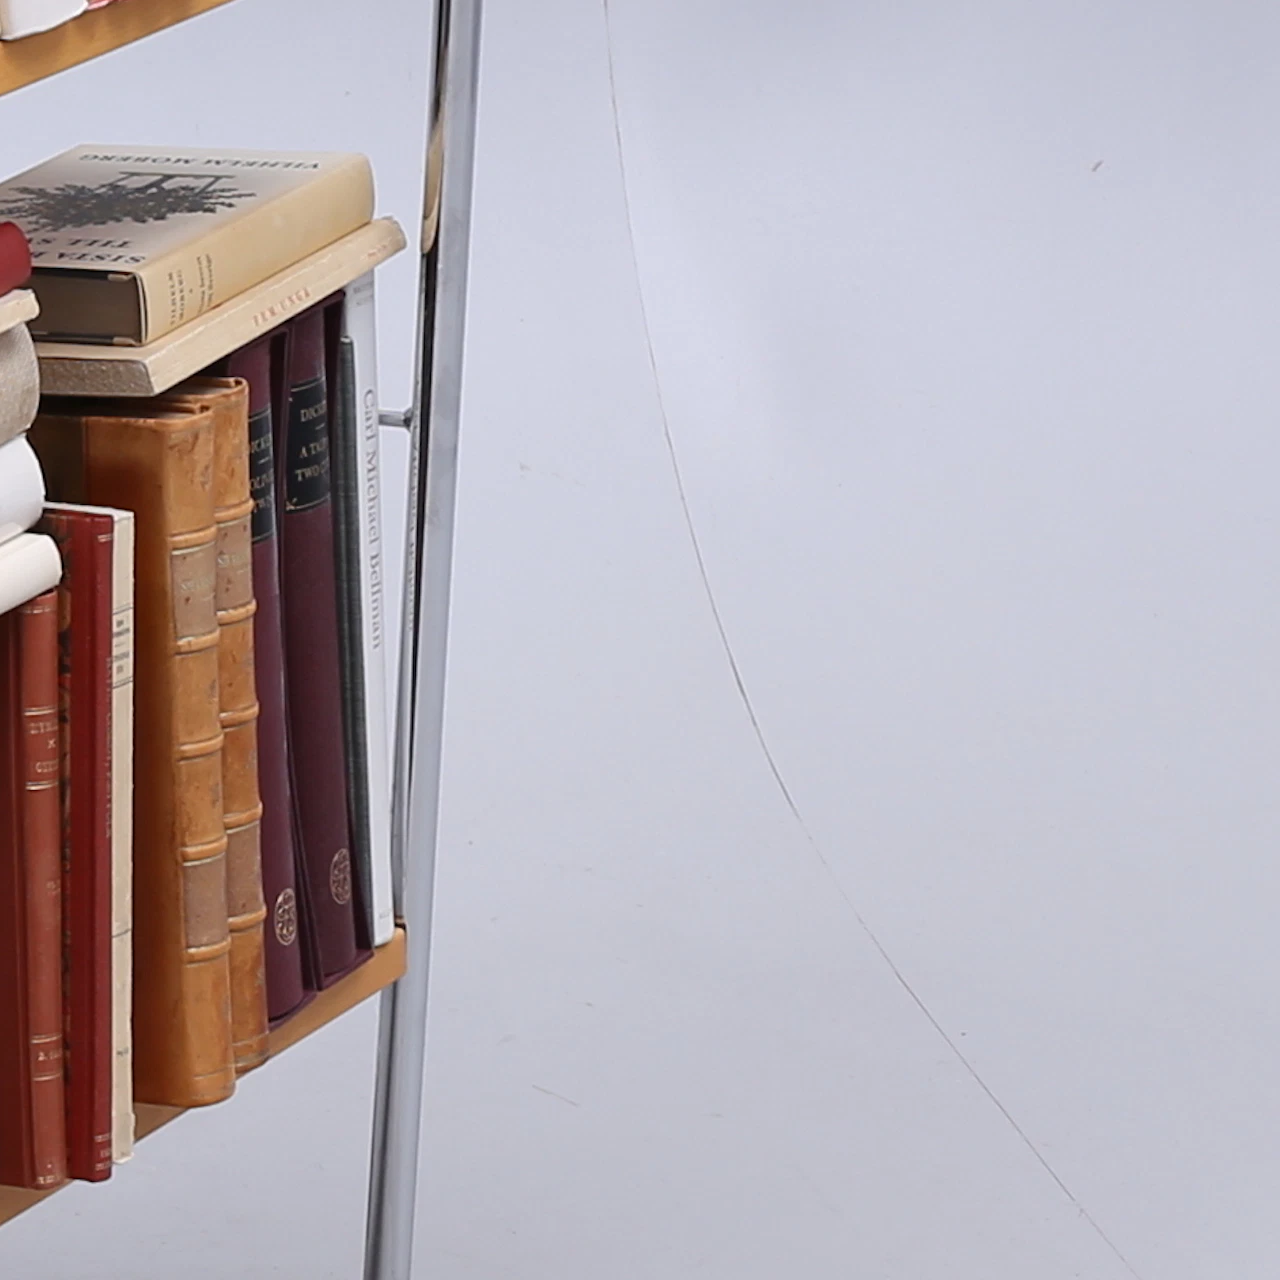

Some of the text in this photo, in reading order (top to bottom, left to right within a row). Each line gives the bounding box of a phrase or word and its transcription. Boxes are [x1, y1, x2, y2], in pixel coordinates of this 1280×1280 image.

[78, 153, 321, 170] VILHELM MOBERG
[67, 238, 133, 249] TILL
[56, 252, 147, 264] SISTA
[362, 388, 382, 651] Carl Michael Bellman
